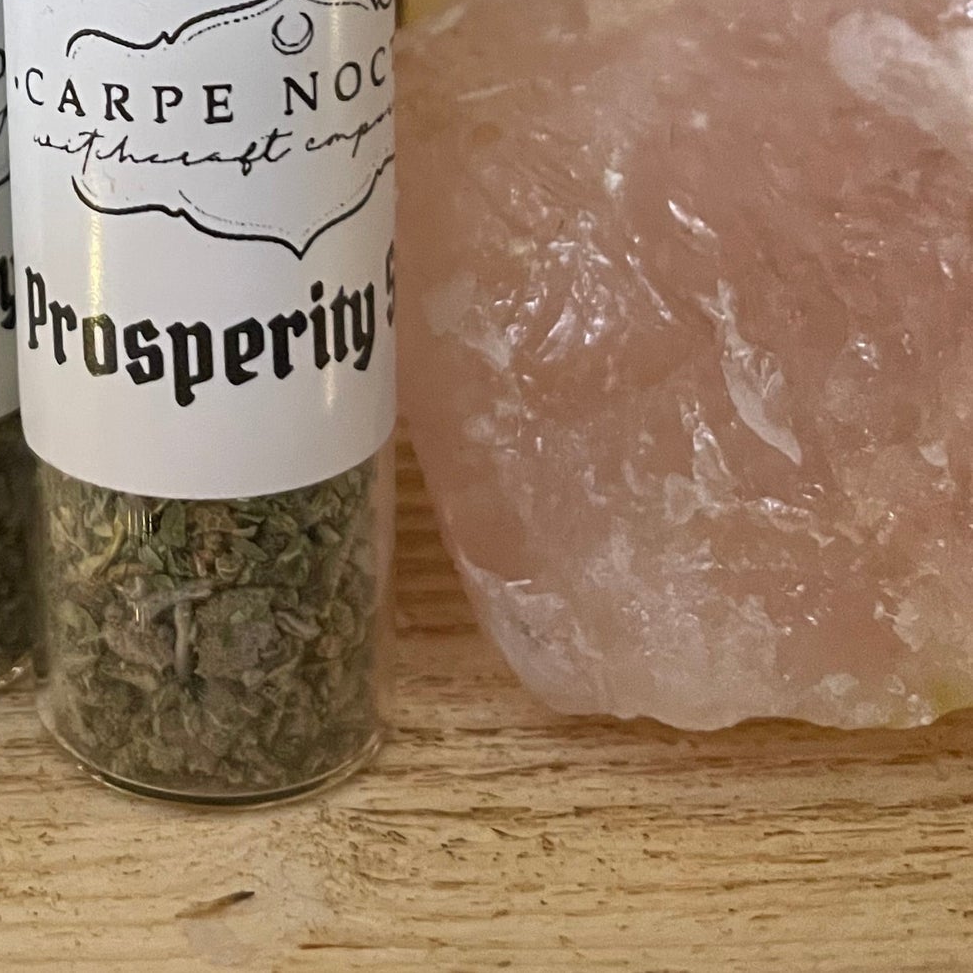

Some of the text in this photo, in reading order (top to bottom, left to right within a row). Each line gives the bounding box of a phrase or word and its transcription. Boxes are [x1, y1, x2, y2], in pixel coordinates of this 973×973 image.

[25, 34, 393, 124] CARPE NOC
[32, 127, 293, 176] witchcraft
[24, 265, 376, 407] Prosperity
